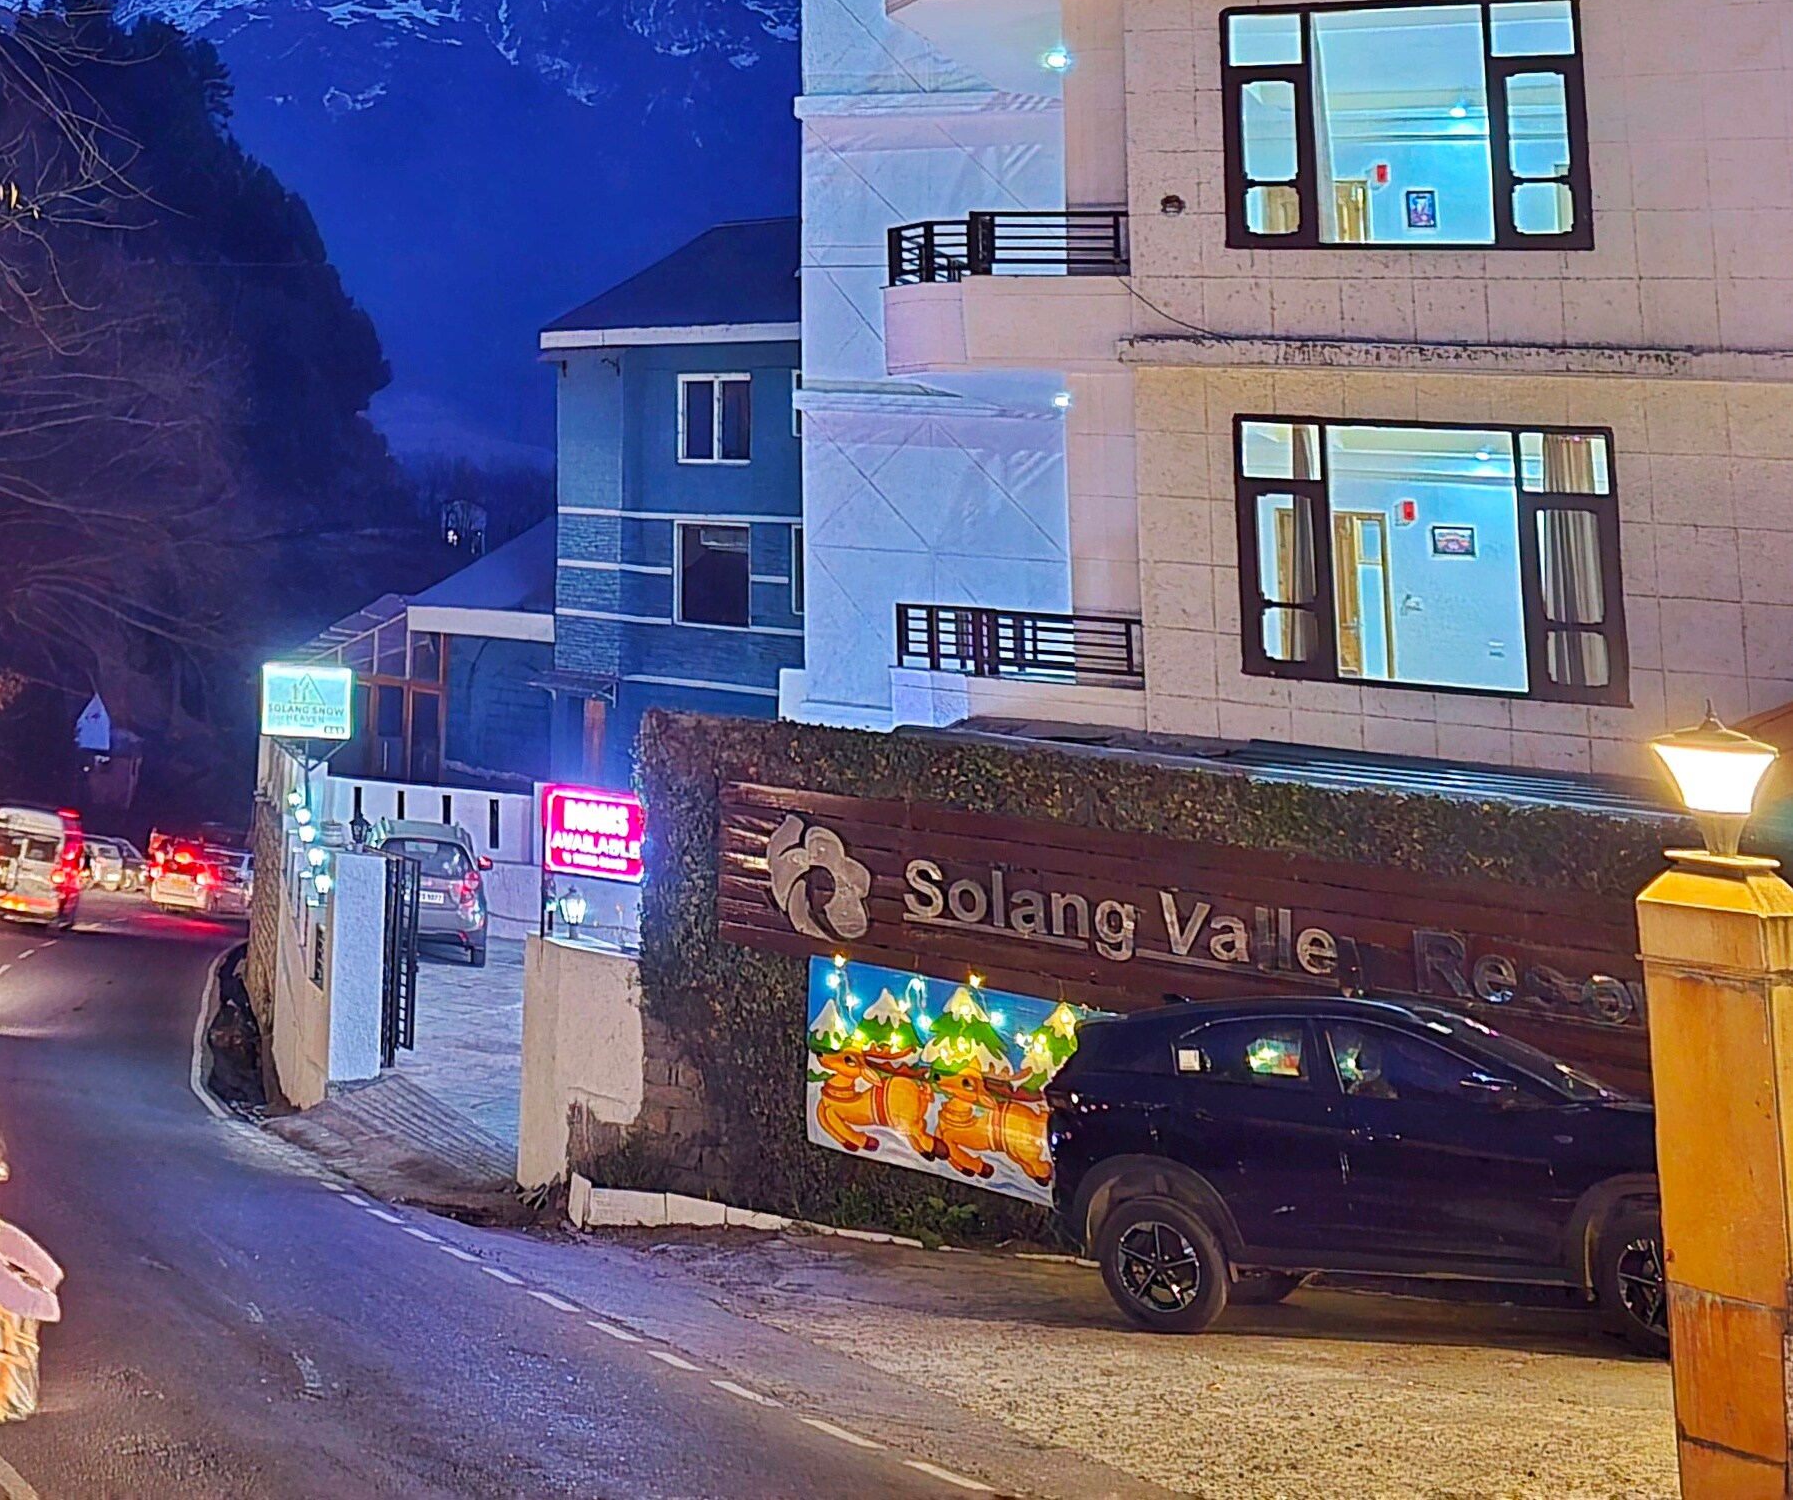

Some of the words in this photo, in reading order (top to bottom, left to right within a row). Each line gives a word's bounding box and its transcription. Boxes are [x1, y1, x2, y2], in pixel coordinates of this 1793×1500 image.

[268, 703, 309, 714] SOLANG
[312, 706, 344, 717] SNOW
[550, 830, 641, 860] AVAILABLE
[903, 858, 1135, 961] Solang
